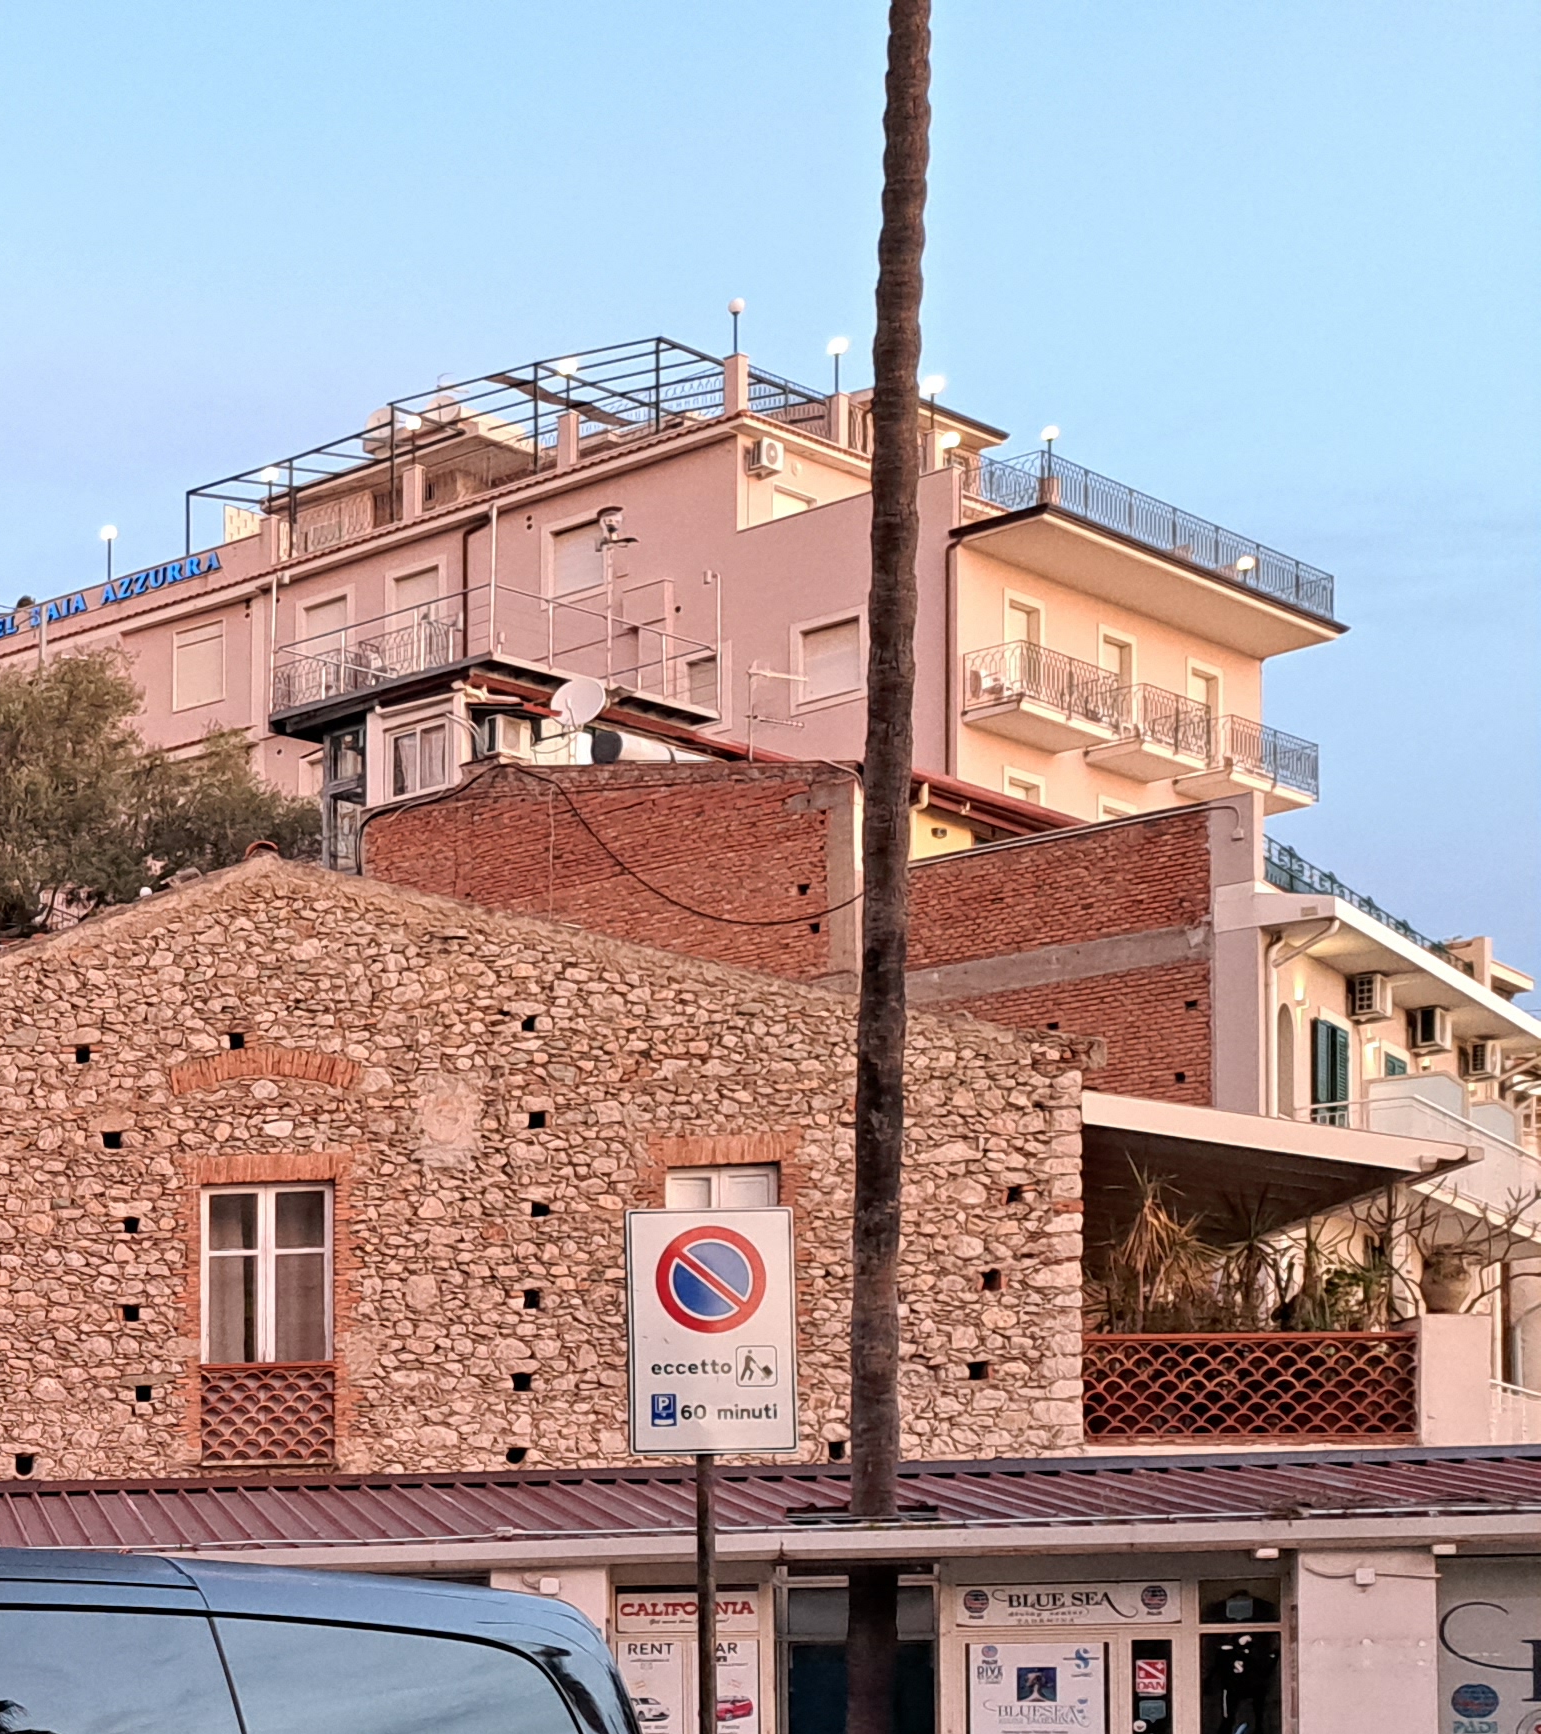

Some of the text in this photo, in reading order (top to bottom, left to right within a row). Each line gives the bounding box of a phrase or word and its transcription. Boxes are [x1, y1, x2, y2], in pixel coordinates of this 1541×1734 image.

[100, 551, 221, 606] AZZURRA
[651, 1359, 732, 1375] eccetto
[681, 1404, 707, 1420] 60
[717, 1403, 778, 1420] minuti
[1008, 1592, 1065, 1609] BLUE
[620, 1601, 755, 1617] CALIFONIA
[627, 1642, 738, 1655] RENT AR
[1137, 1681, 1165, 1691] DAN
[1453, 1721, 1498, 1734] PADI
